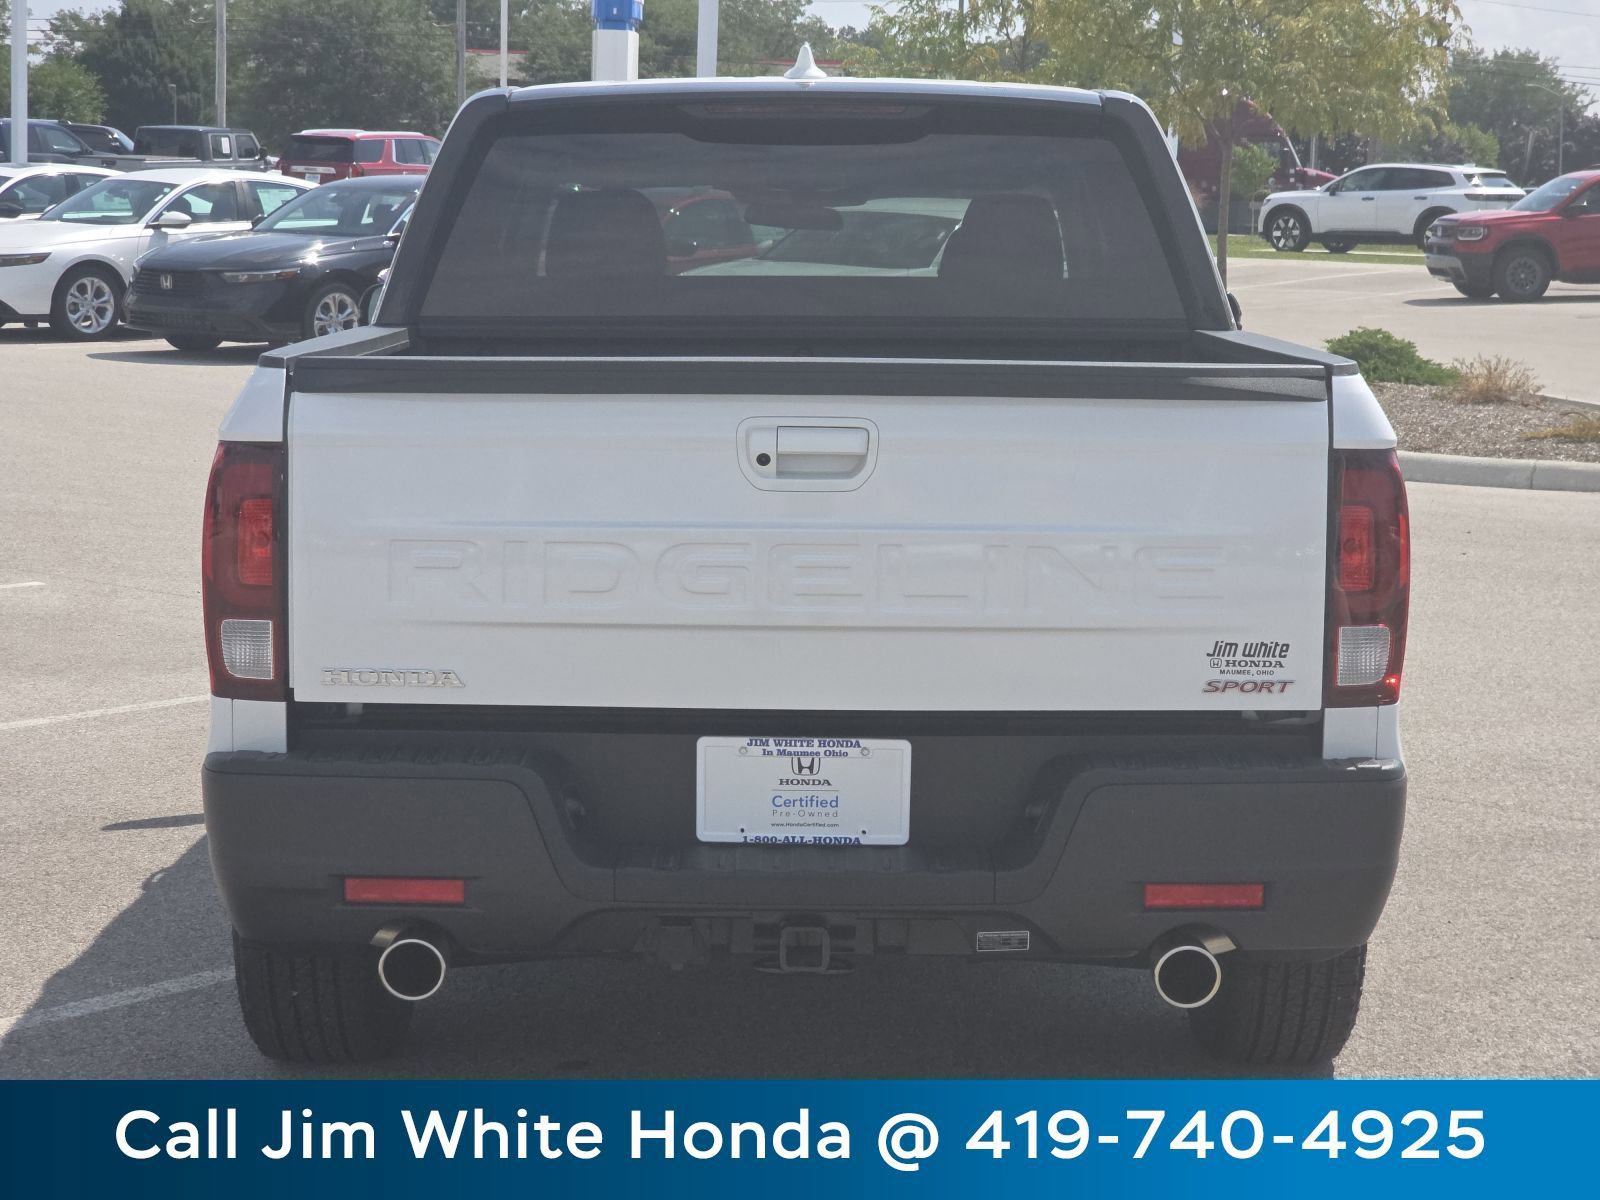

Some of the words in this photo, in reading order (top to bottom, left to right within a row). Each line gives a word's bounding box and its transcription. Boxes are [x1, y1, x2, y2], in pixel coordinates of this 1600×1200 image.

[388, 539, 1224, 613] RIDGELINE
[1206, 640, 1238, 658] Jim
[1224, 659, 1284, 668] HONDA
[320, 668, 466, 688] HONDA
[1219, 669, 1254, 677] MAUMEE,
[1203, 680, 1296, 694] SPORT
[747, 738, 770, 748] JIM
[773, 739, 815, 748] WHITE
[818, 740, 862, 749] HONDA
[762, 749, 773, 757] In
[777, 749, 821, 757] Maumee
[824, 750, 849, 758] Ohio
[778, 778, 832, 786] HONDA
[772, 795, 839, 808] Certified
[772, 809, 838, 819] Pre-Owned
[742, 836, 861, 846] 1-800-ALL-HONDA
